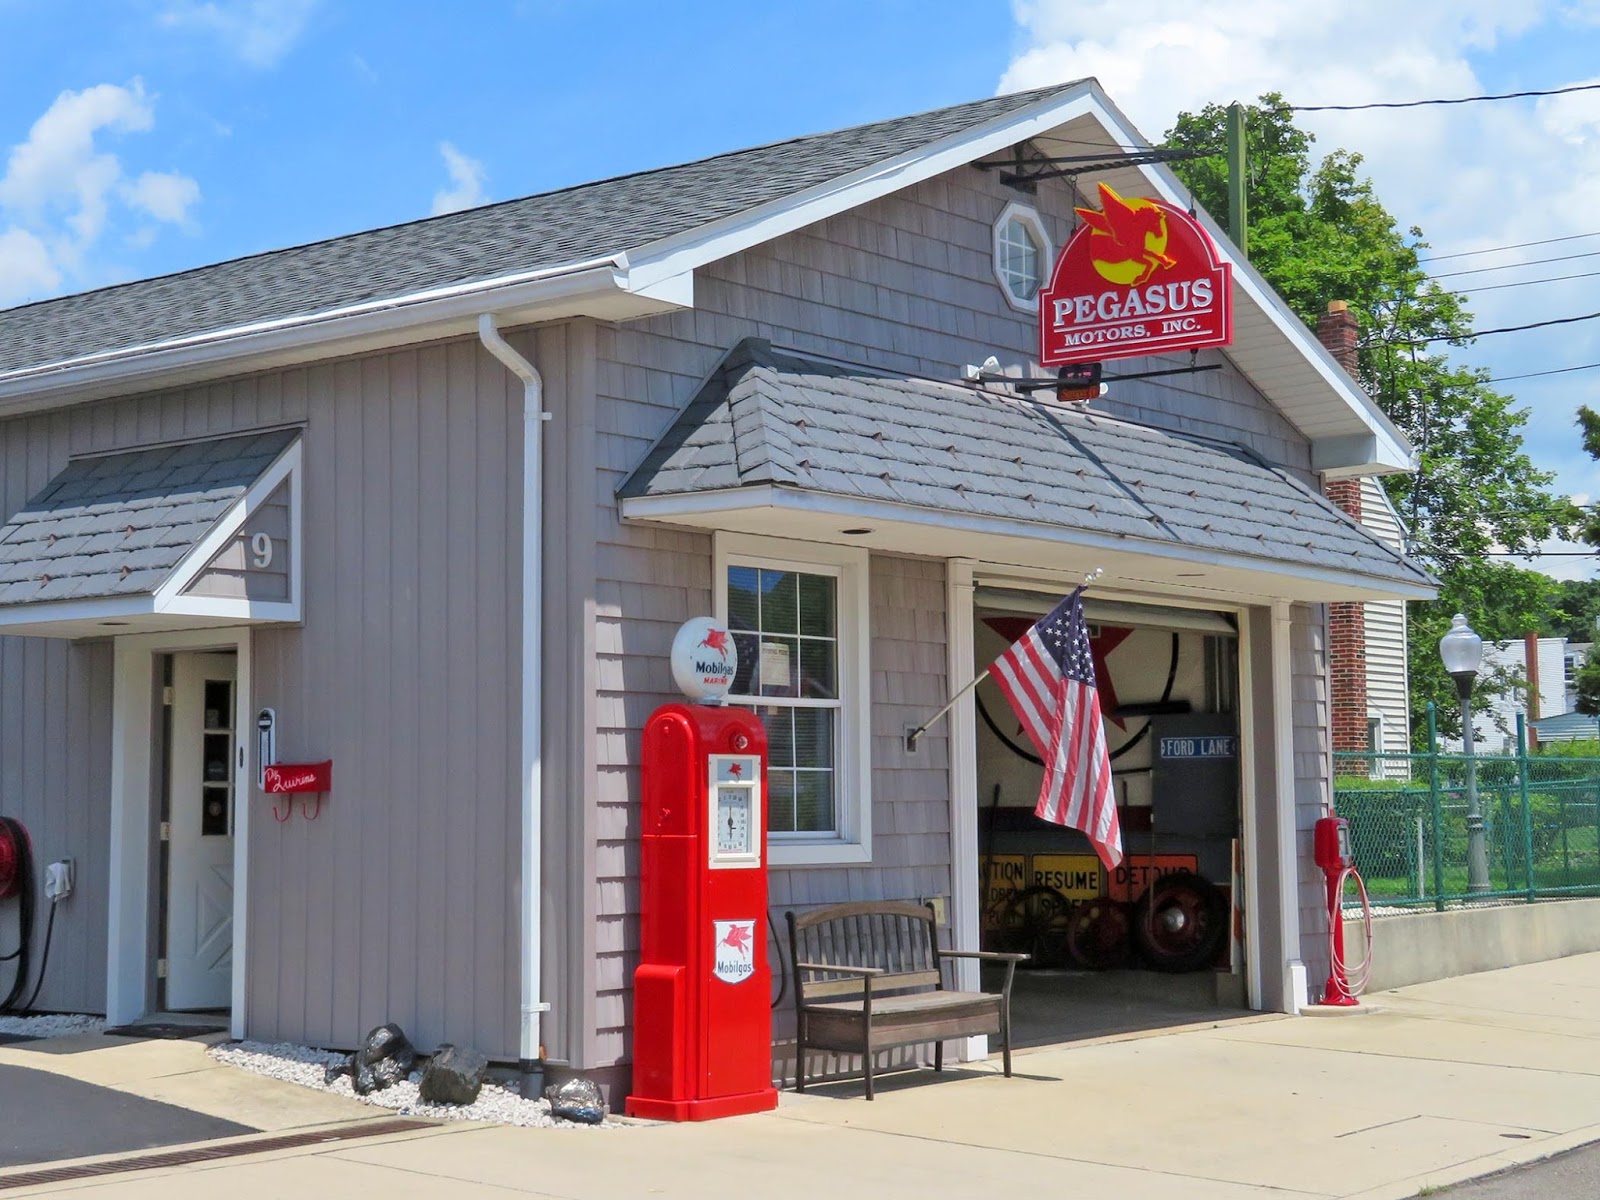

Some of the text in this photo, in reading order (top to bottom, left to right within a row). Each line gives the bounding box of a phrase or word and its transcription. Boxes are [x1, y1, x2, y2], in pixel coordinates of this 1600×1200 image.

[1052, 278, 1214, 327] PEGASUS
[1064, 317, 1202, 347] MOTORS, INC.
[251, 532, 273, 569] 9
[695, 660, 734, 678] Mobilgas
[703, 676, 729, 686] MARINE
[1167, 739, 1231, 756] FORD LANE
[1034, 870, 1098, 890] RESUME
[717, 959, 752, 977] Mobilgas
